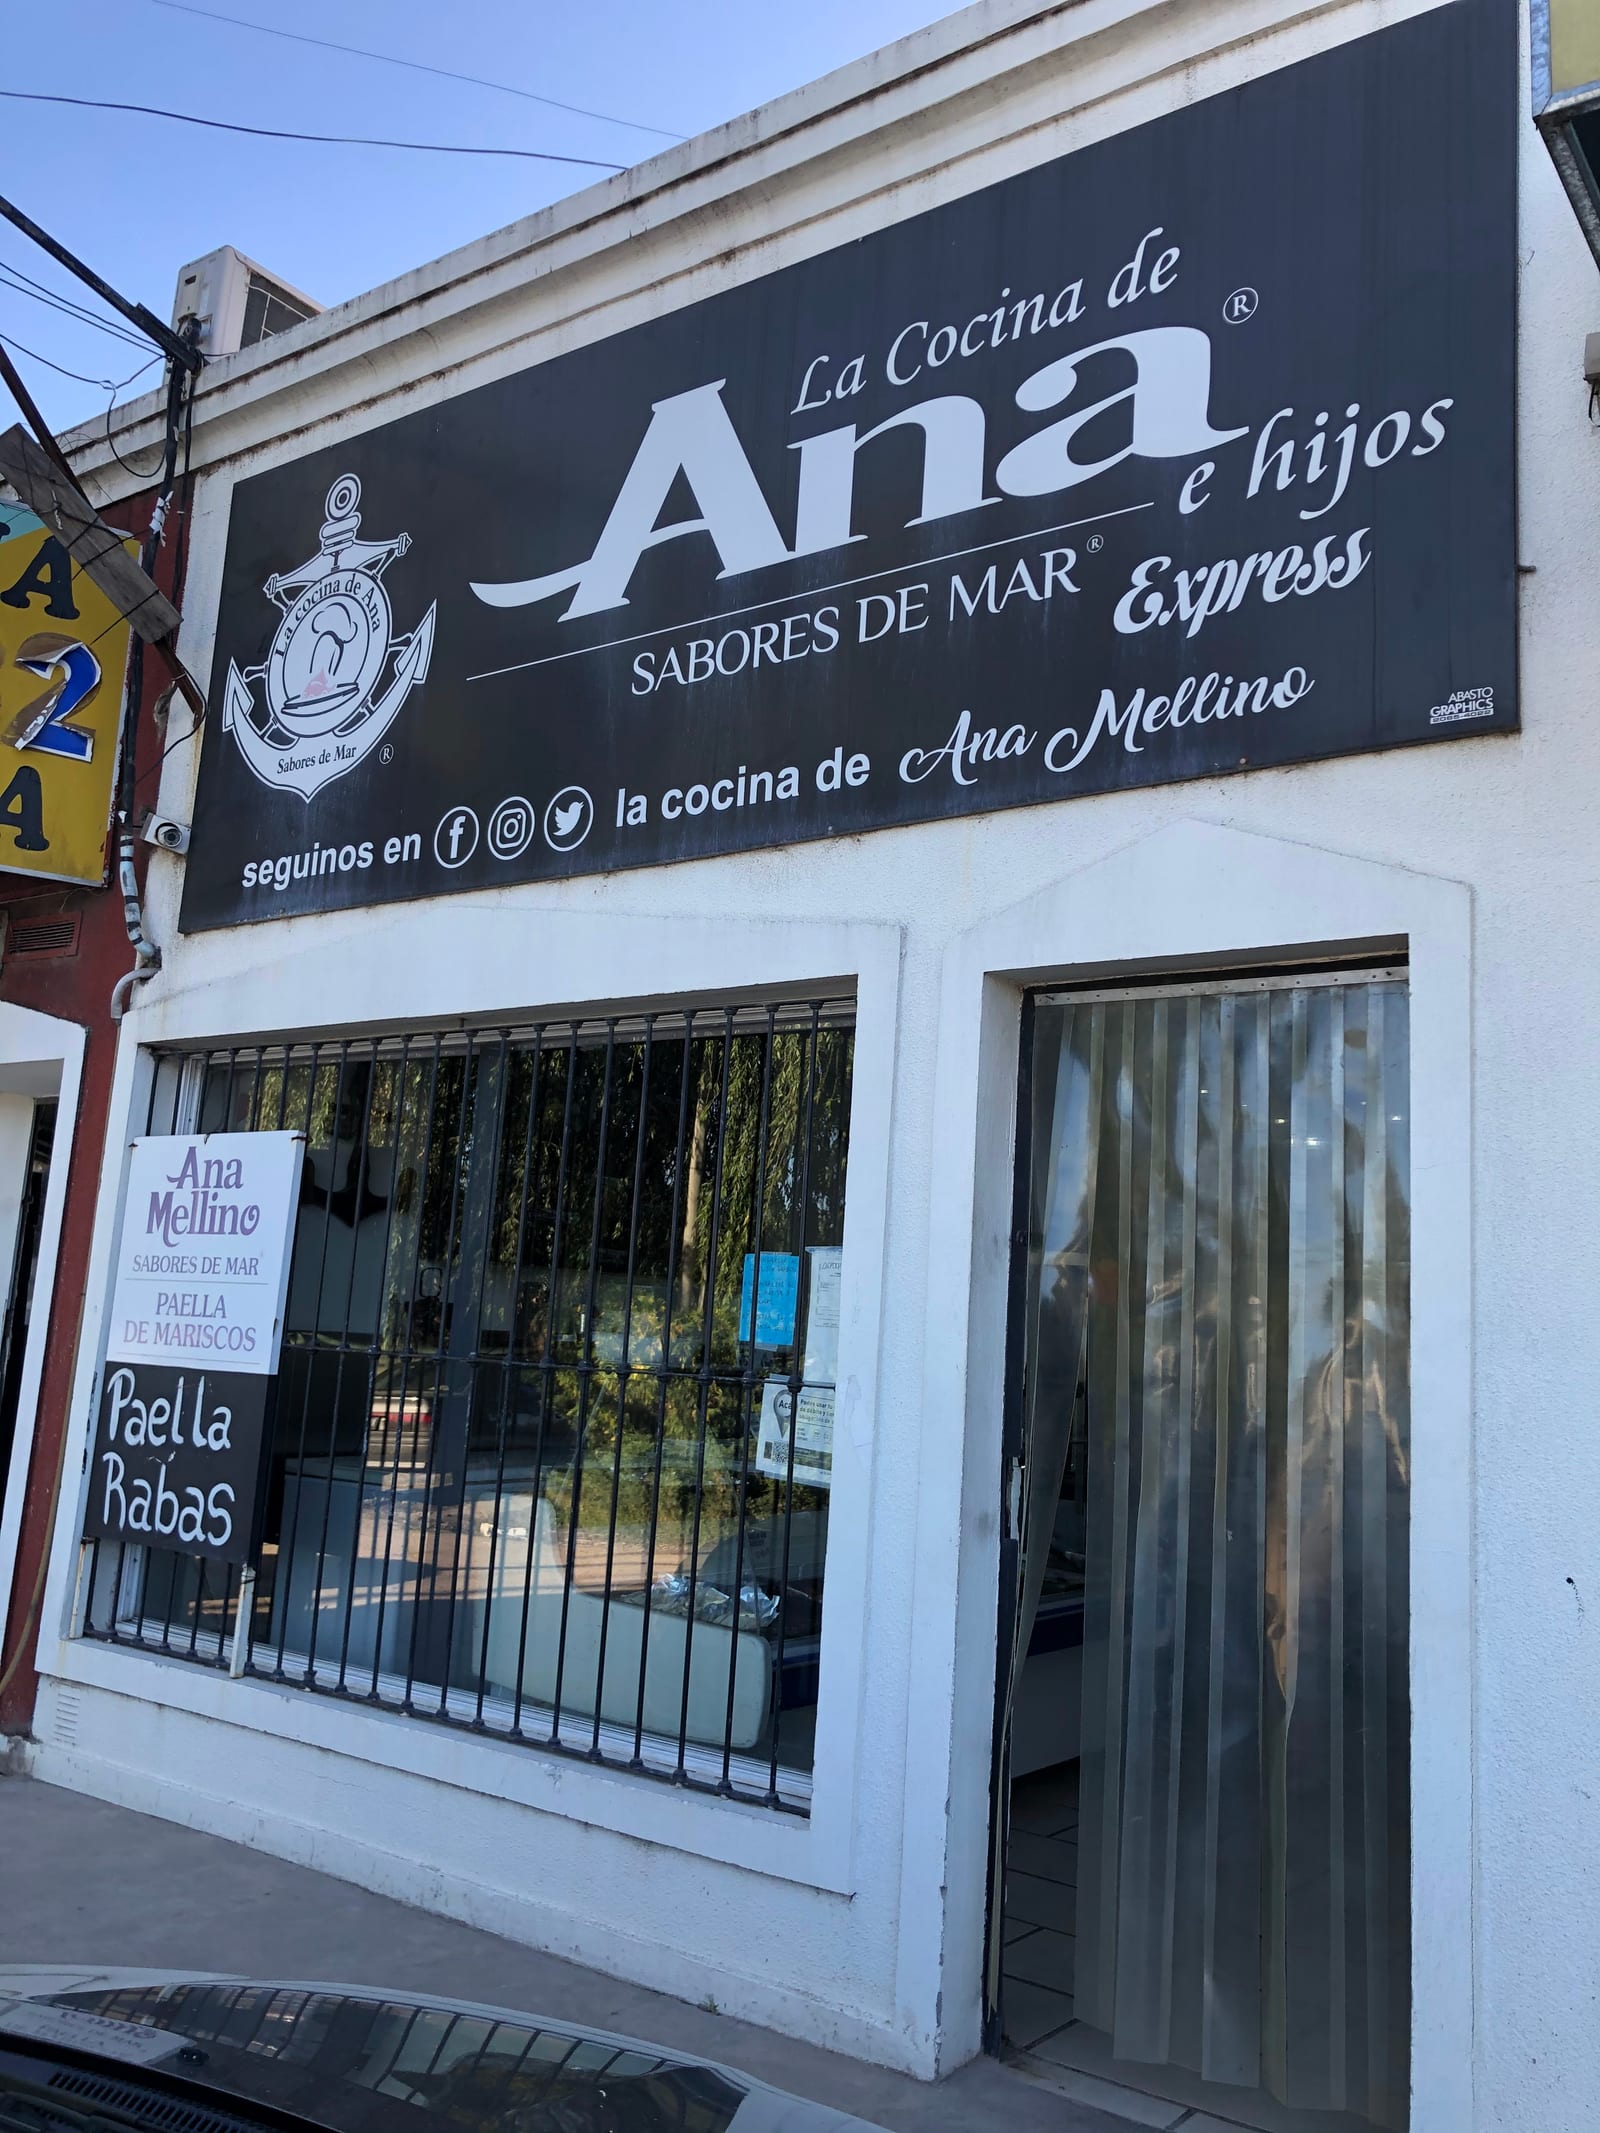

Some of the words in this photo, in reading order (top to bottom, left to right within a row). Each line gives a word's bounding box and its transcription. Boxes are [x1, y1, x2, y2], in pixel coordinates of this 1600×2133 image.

[791, 355, 867, 416] La
[886, 278, 1085, 386] Cocina
[1106, 227, 1180, 308] de
[469, 326, 1250, 622] Ana
[1179, 461, 1214, 515] e
[1247, 397, 1454, 521] hijos
[275, 627, 293, 657] La
[295, 579, 340, 621] cocina
[344, 573, 361, 595] de
[362, 587, 381, 634] Ana
[1113, 527, 1372, 639] Express
[632, 608, 839, 695] SABORES
[857, 584, 930, 644] DE
[948, 547, 1082, 618] MAR
[1430, 698, 1494, 717] GRAPHICS
[1448, 687, 1494, 703] ABASTO
[277, 756, 316, 774] Sabores
[318, 749, 331, 764] de
[334, 744, 357, 762] Mar
[616, 789, 647, 827] la
[661, 765, 799, 820] cocina
[815, 747, 870, 792] de
[899, 710, 1038, 786] Ana
[1045, 667, 1315, 774] Mellino
[242, 842, 374, 891] seguinos
[383, 830, 421, 863] en
[167, 1146, 242, 1190] Ana
[146, 1191, 260, 1247] Mellino
[133, 1255, 197, 1275] SABORES
[201, 1257, 221, 1275] DE
[225, 1257, 258, 1276] MAR
[123, 1320, 149, 1344] DE
[153, 1322, 256, 1352] MARISCOS
[156, 1292, 226, 1319] PAELLA
[107, 1367, 231, 1451] Paella
[102, 1451, 235, 1547] Rabas
